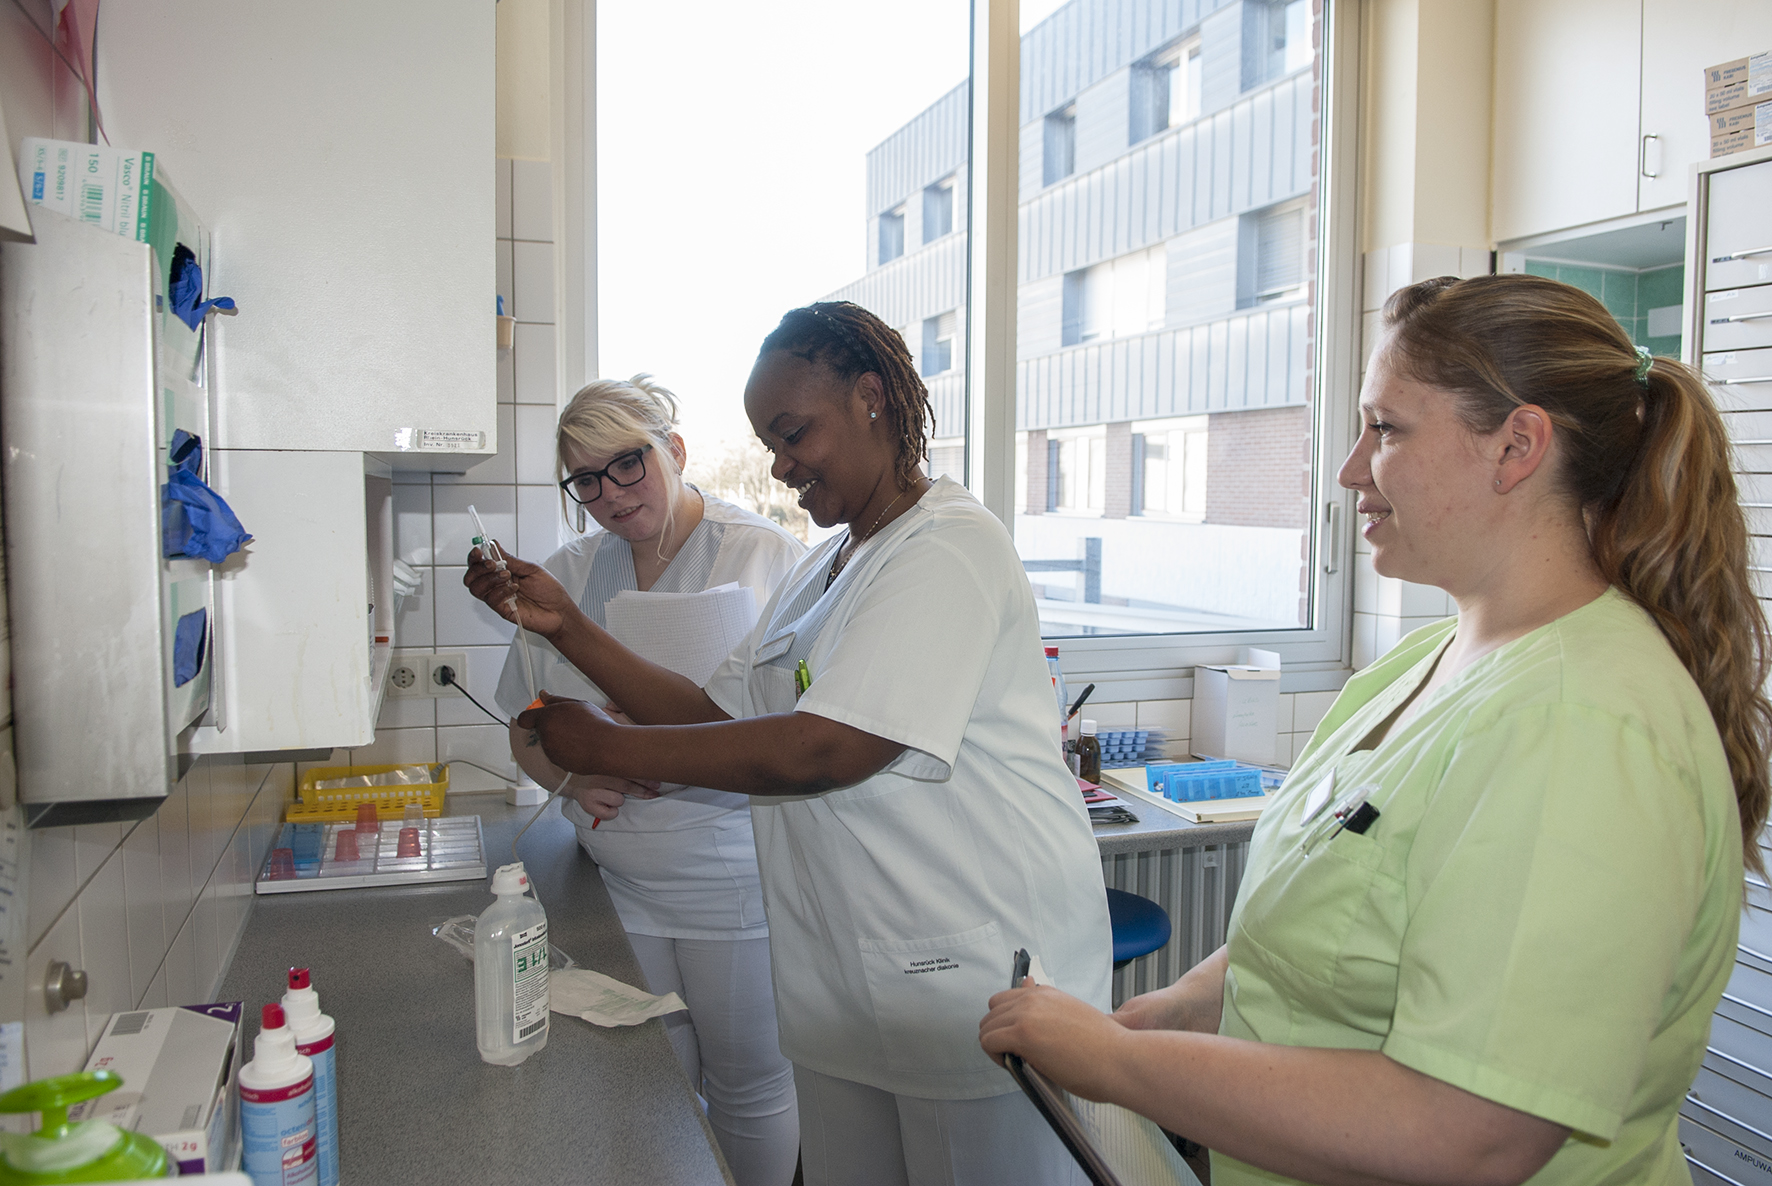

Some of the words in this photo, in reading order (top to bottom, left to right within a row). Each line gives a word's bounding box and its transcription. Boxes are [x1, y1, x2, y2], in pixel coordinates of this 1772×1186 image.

[1723, 65, 1747, 75] FRESENIUS
[1722, 94, 1740, 102] volume
[1729, 112, 1753, 121] FRESENIUS
[1726, 142, 1744, 150] volume
[88, 153, 99, 173] 150
[143, 162, 153, 186] BRAUN
[56, 164, 66, 201] 9209817
[120, 194, 132, 219] Nitril
[140, 196, 150, 219] BRAUN
[118, 221, 130, 236] blu
[531, 946, 547, 966] 1/1
[910, 959, 936, 967] Hunsrück
[516, 956, 527, 973] E
[936, 963, 959, 971] diakonie
[181, 1141, 198, 1153] 2g
